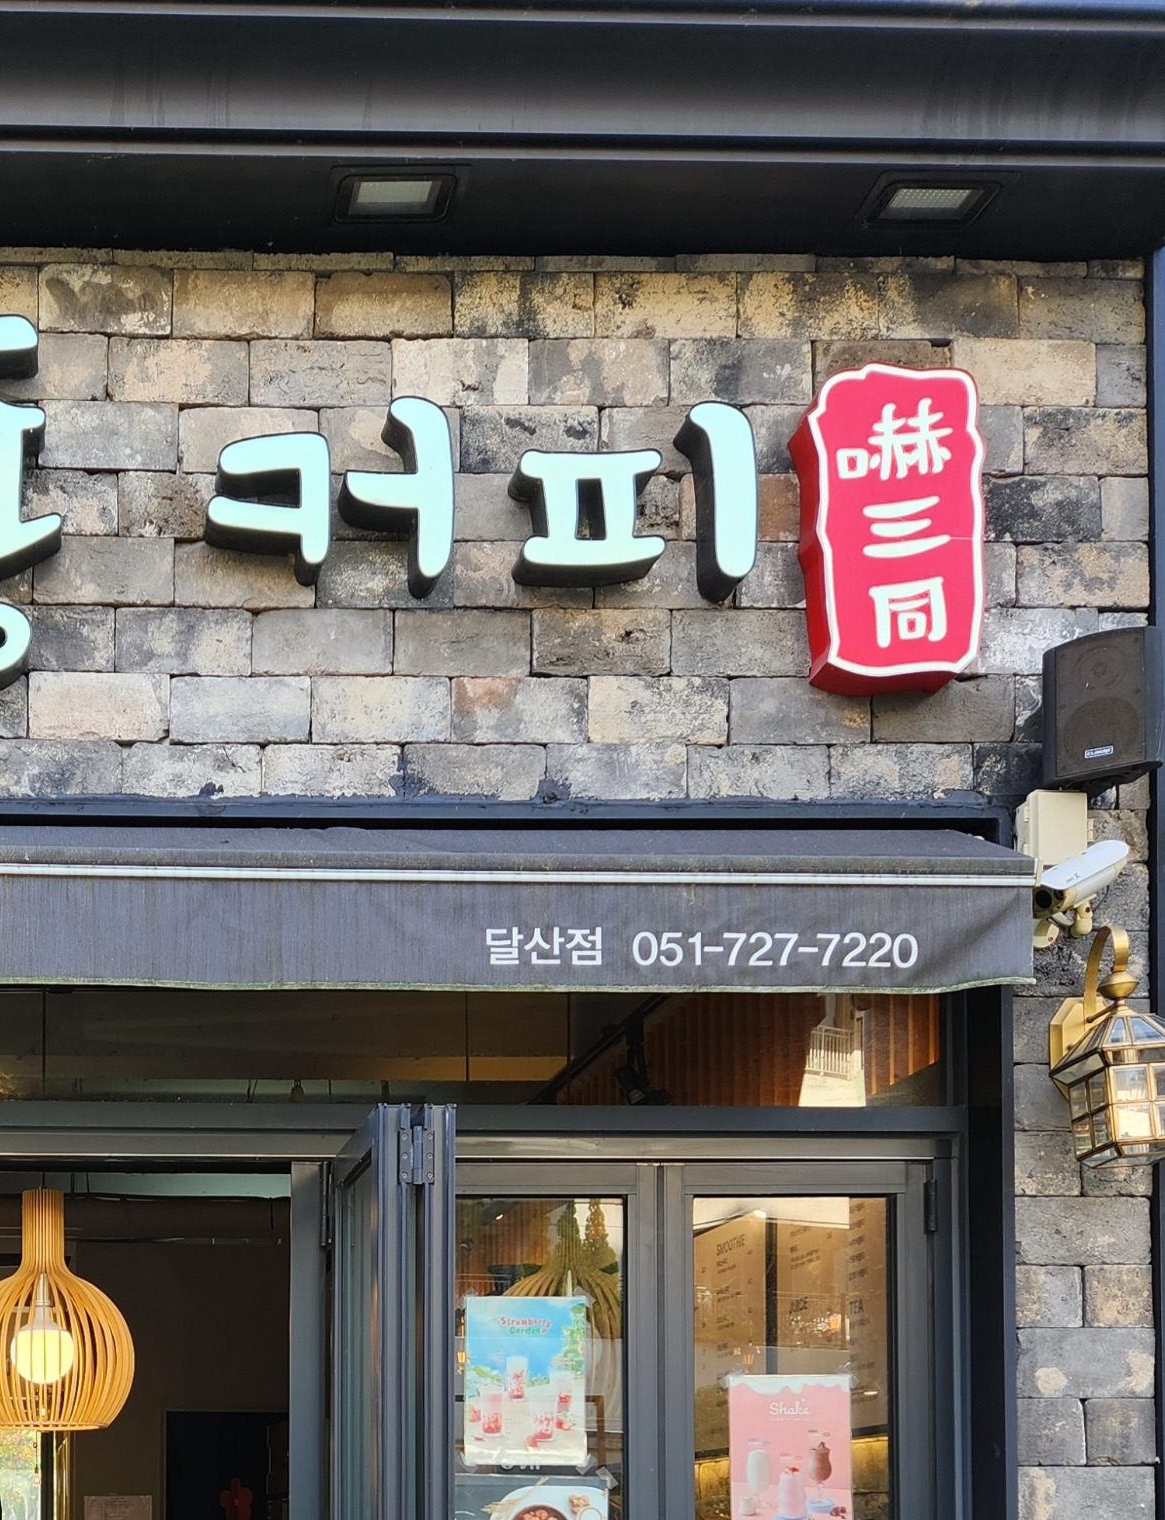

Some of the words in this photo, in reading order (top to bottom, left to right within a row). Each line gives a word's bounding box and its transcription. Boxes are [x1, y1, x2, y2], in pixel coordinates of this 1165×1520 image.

[204, 395, 759, 600] 커피
[484, 926, 604, 967] 달산점
[631, 930, 919, 969] 051-727-7220
[716, 1233, 746, 1256] SMOOTHIE
[849, 1299, 864, 1315] TEA
[770, 1400, 812, 1415] Shake
